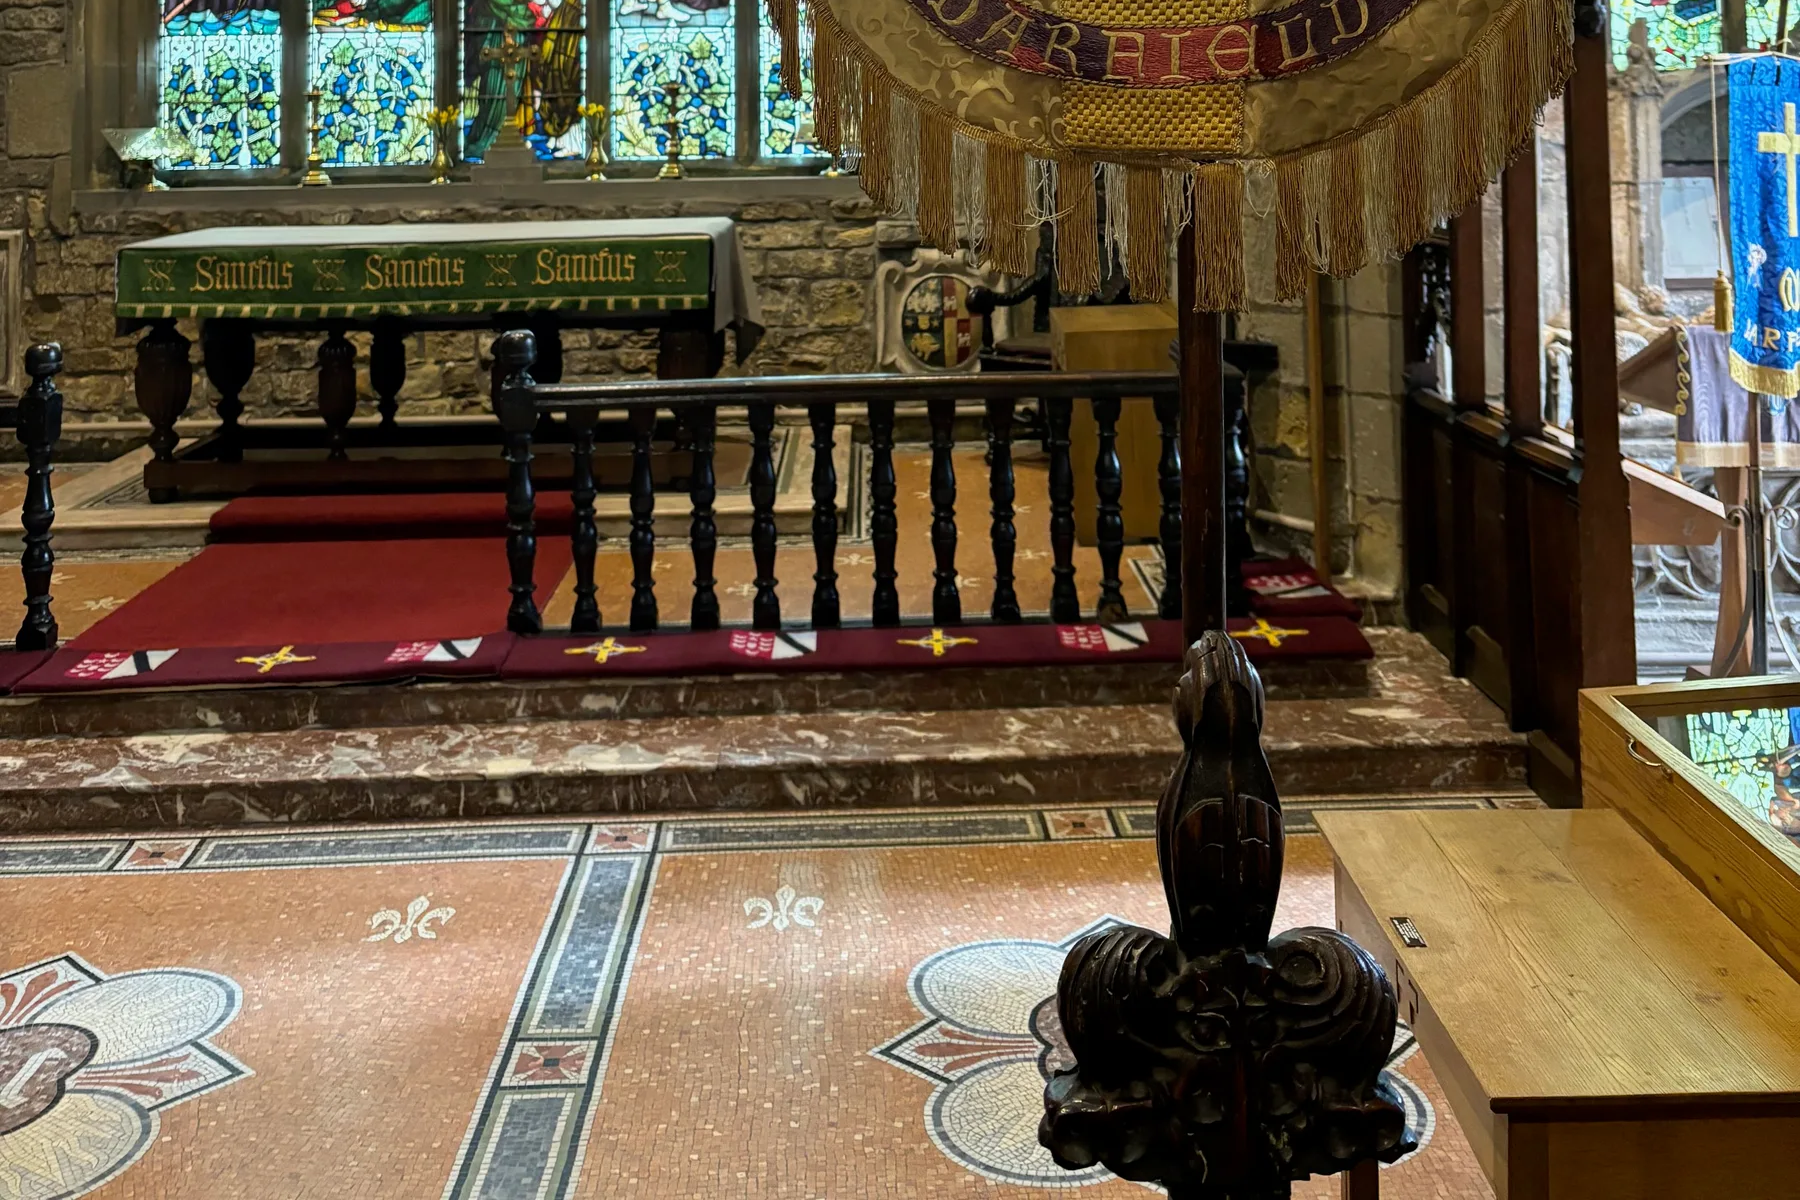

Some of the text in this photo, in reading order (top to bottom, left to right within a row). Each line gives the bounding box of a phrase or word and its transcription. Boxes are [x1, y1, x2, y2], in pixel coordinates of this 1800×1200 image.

[189, 254, 294, 293] Sanctus
[360, 252, 466, 291] Sanctus
[531, 247, 637, 286] Sanctus
